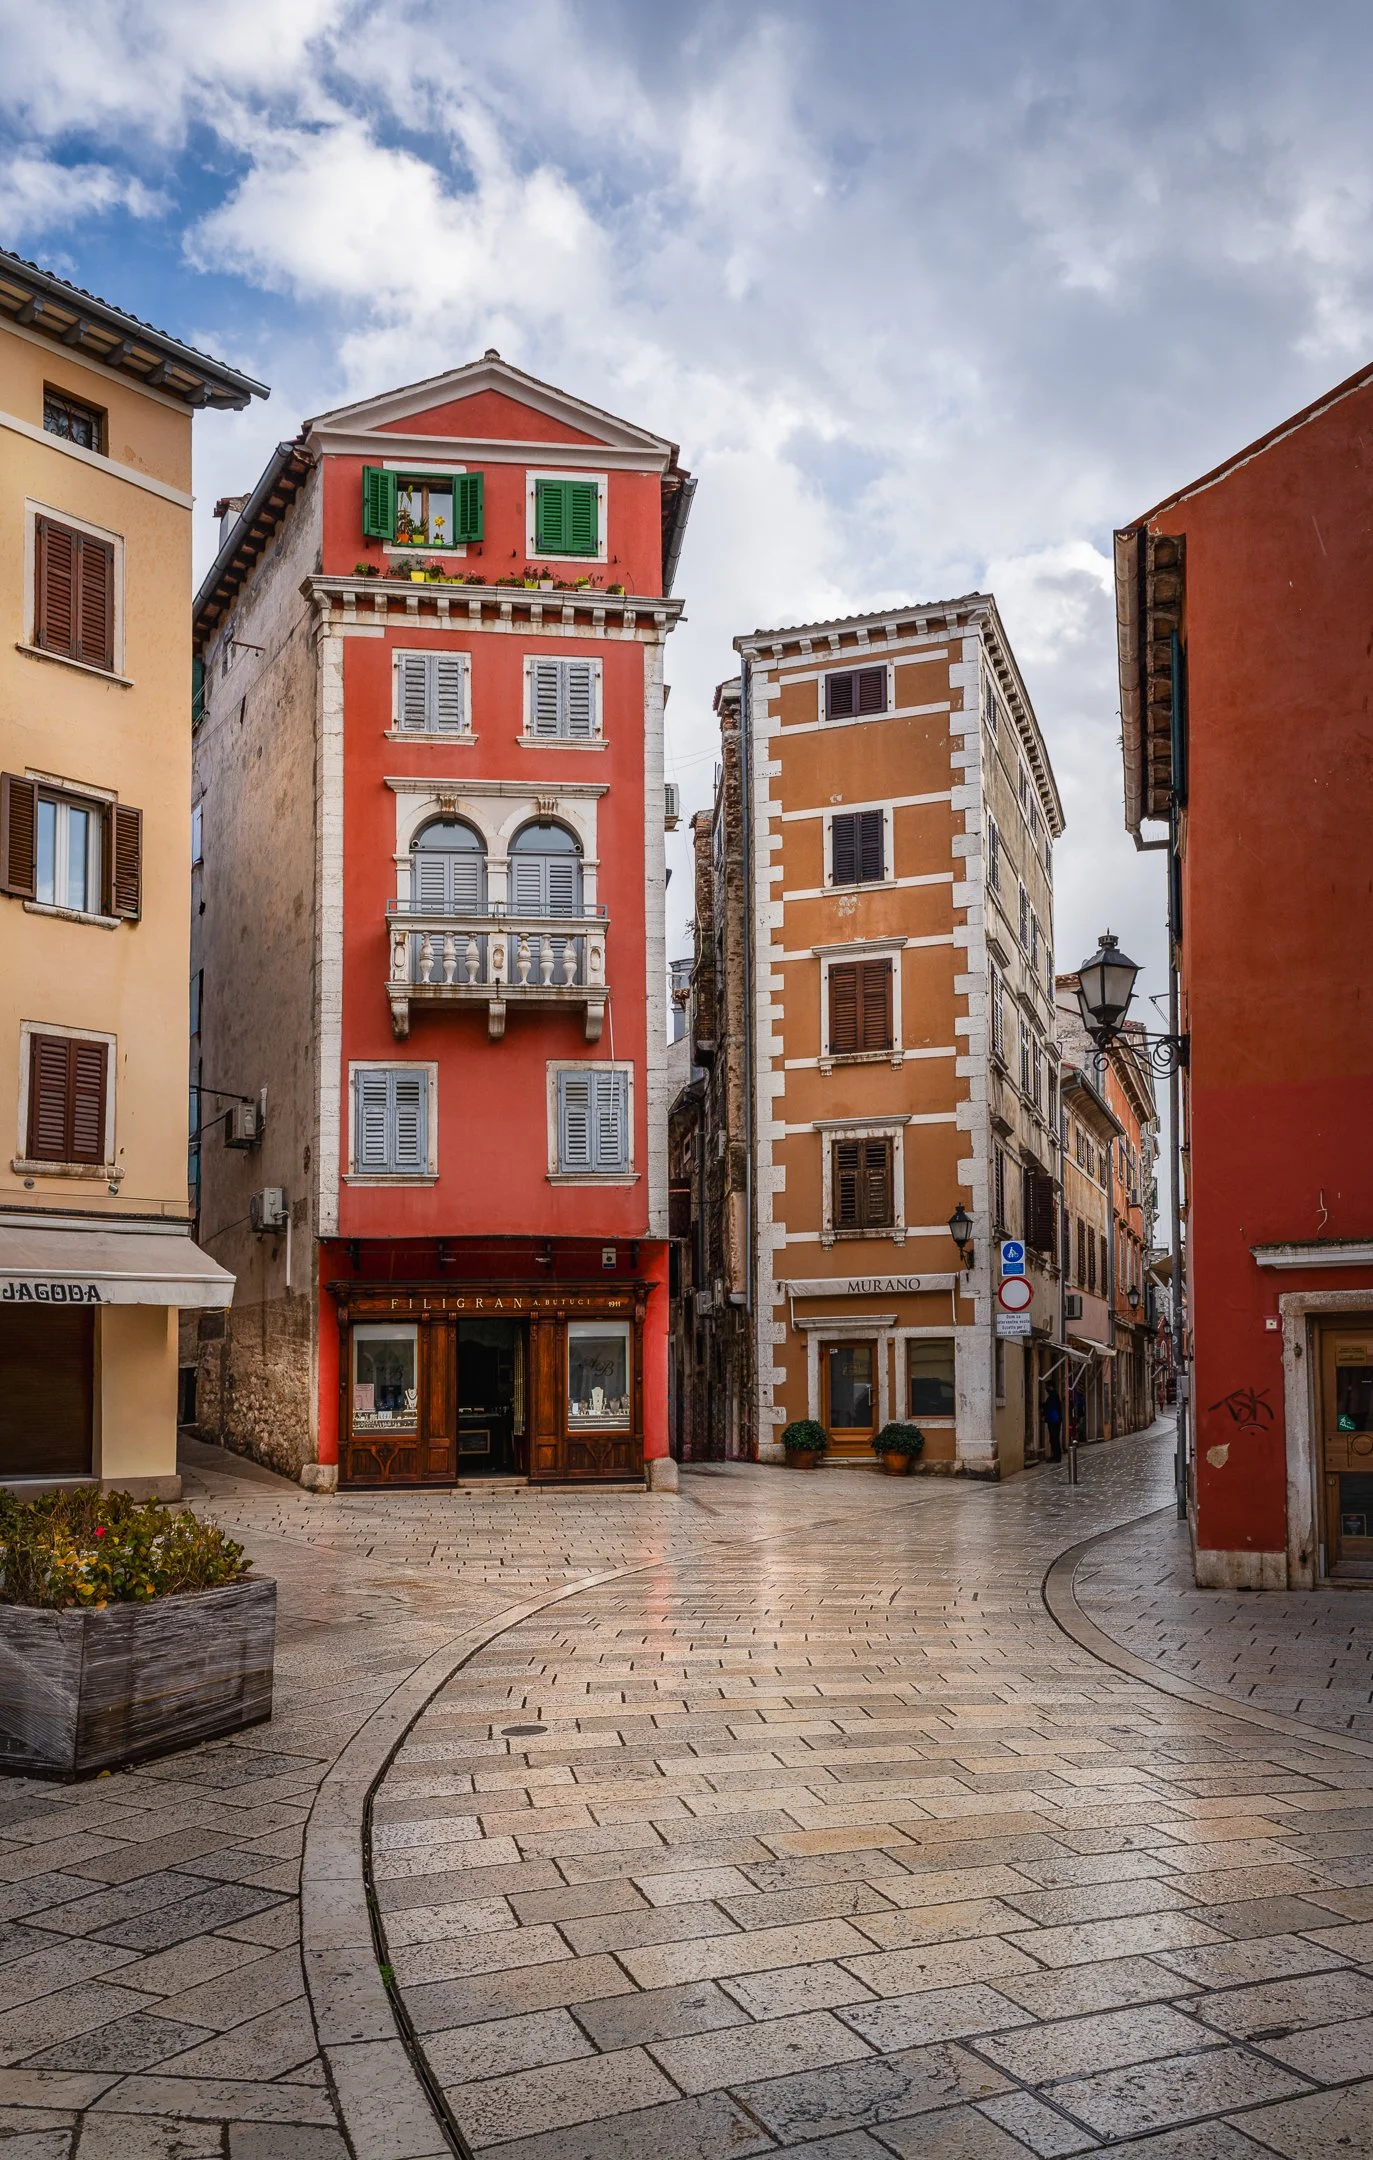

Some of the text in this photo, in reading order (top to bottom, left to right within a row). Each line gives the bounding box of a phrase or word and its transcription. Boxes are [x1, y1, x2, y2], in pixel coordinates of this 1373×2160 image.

[2, 1282, 102, 1302] JAGODA
[847, 1278, 921, 1293] MURANO
[390, 1298, 523, 1310] FILIGRAN
